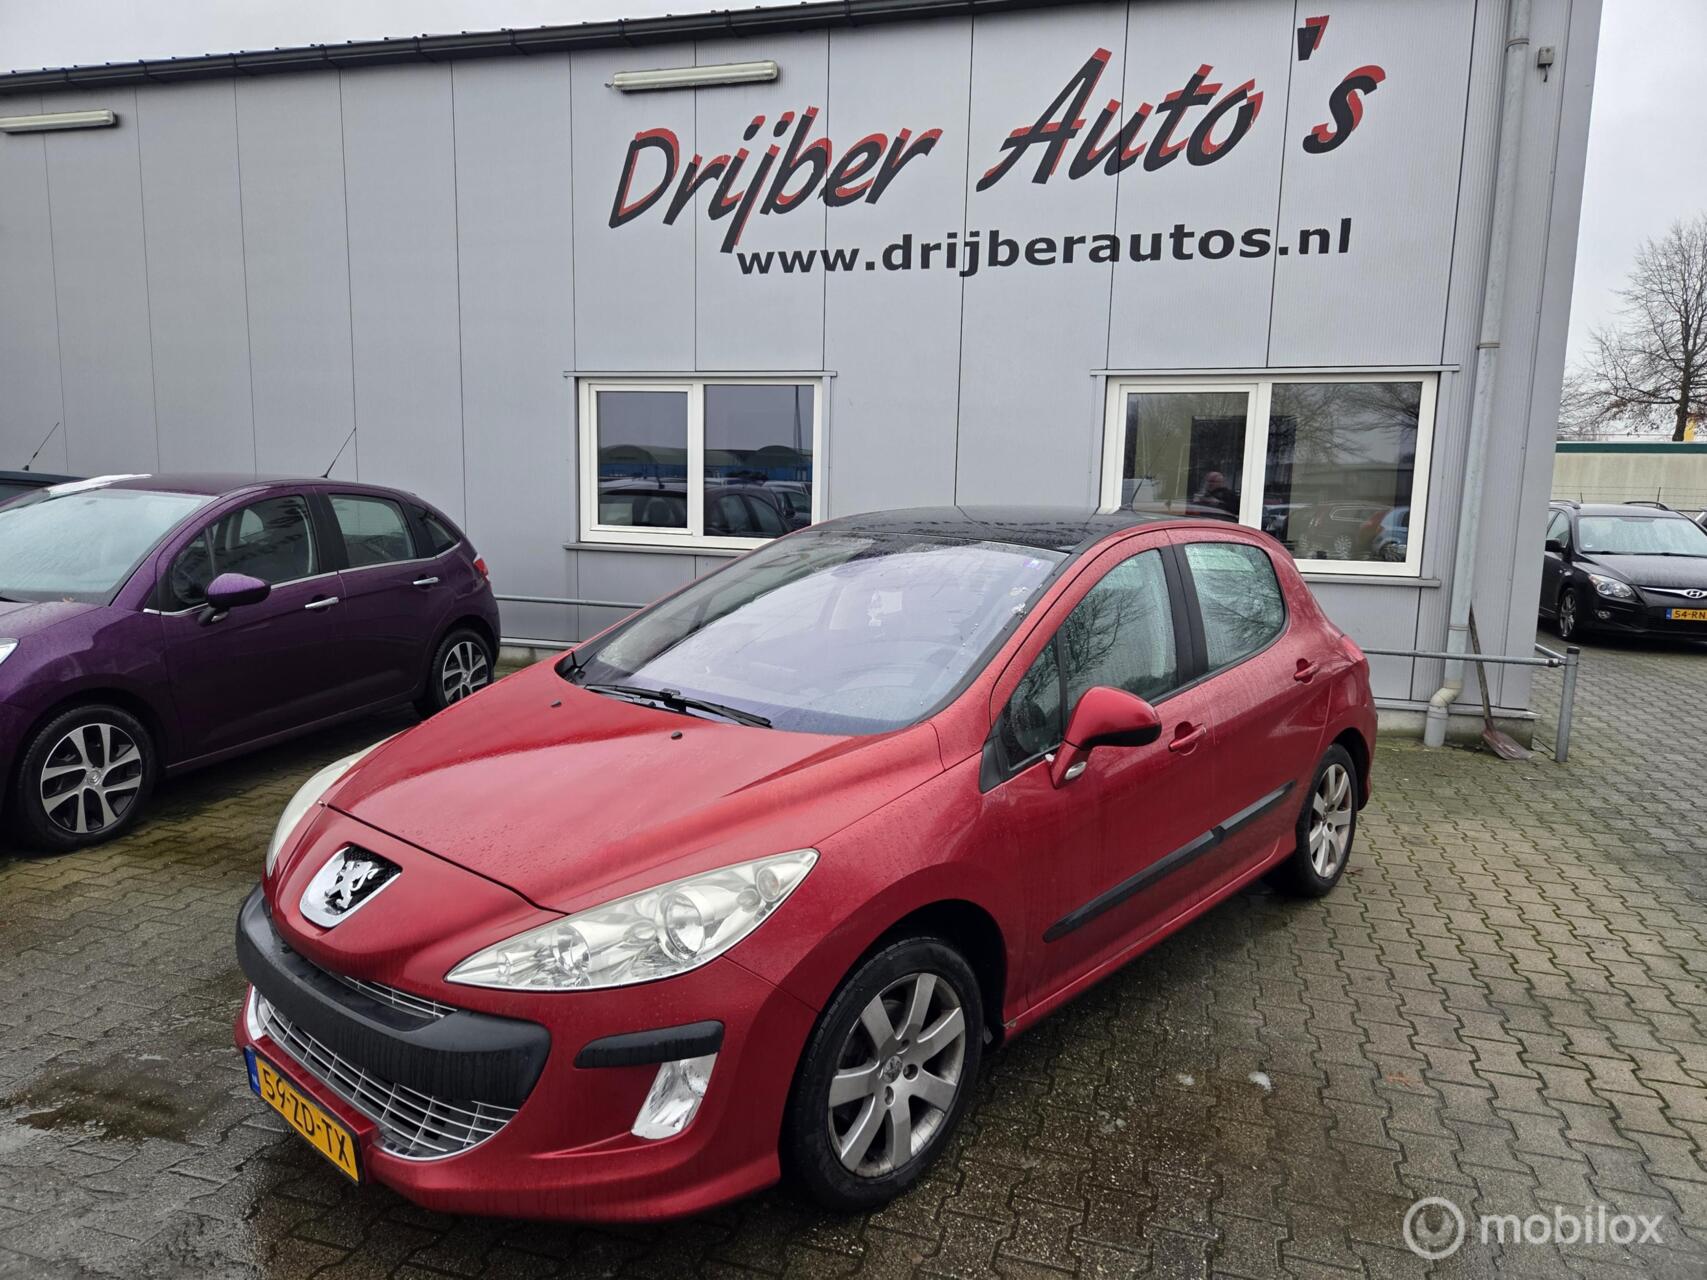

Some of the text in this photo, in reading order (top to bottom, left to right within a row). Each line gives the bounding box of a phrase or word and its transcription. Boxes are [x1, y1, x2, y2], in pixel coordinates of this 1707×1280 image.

[608, 15, 1386, 254] Drijber Auto's
[737, 217, 1352, 278] www.drijberautos.nl
[262, 1068, 350, 1168] 59-ZD-TX
